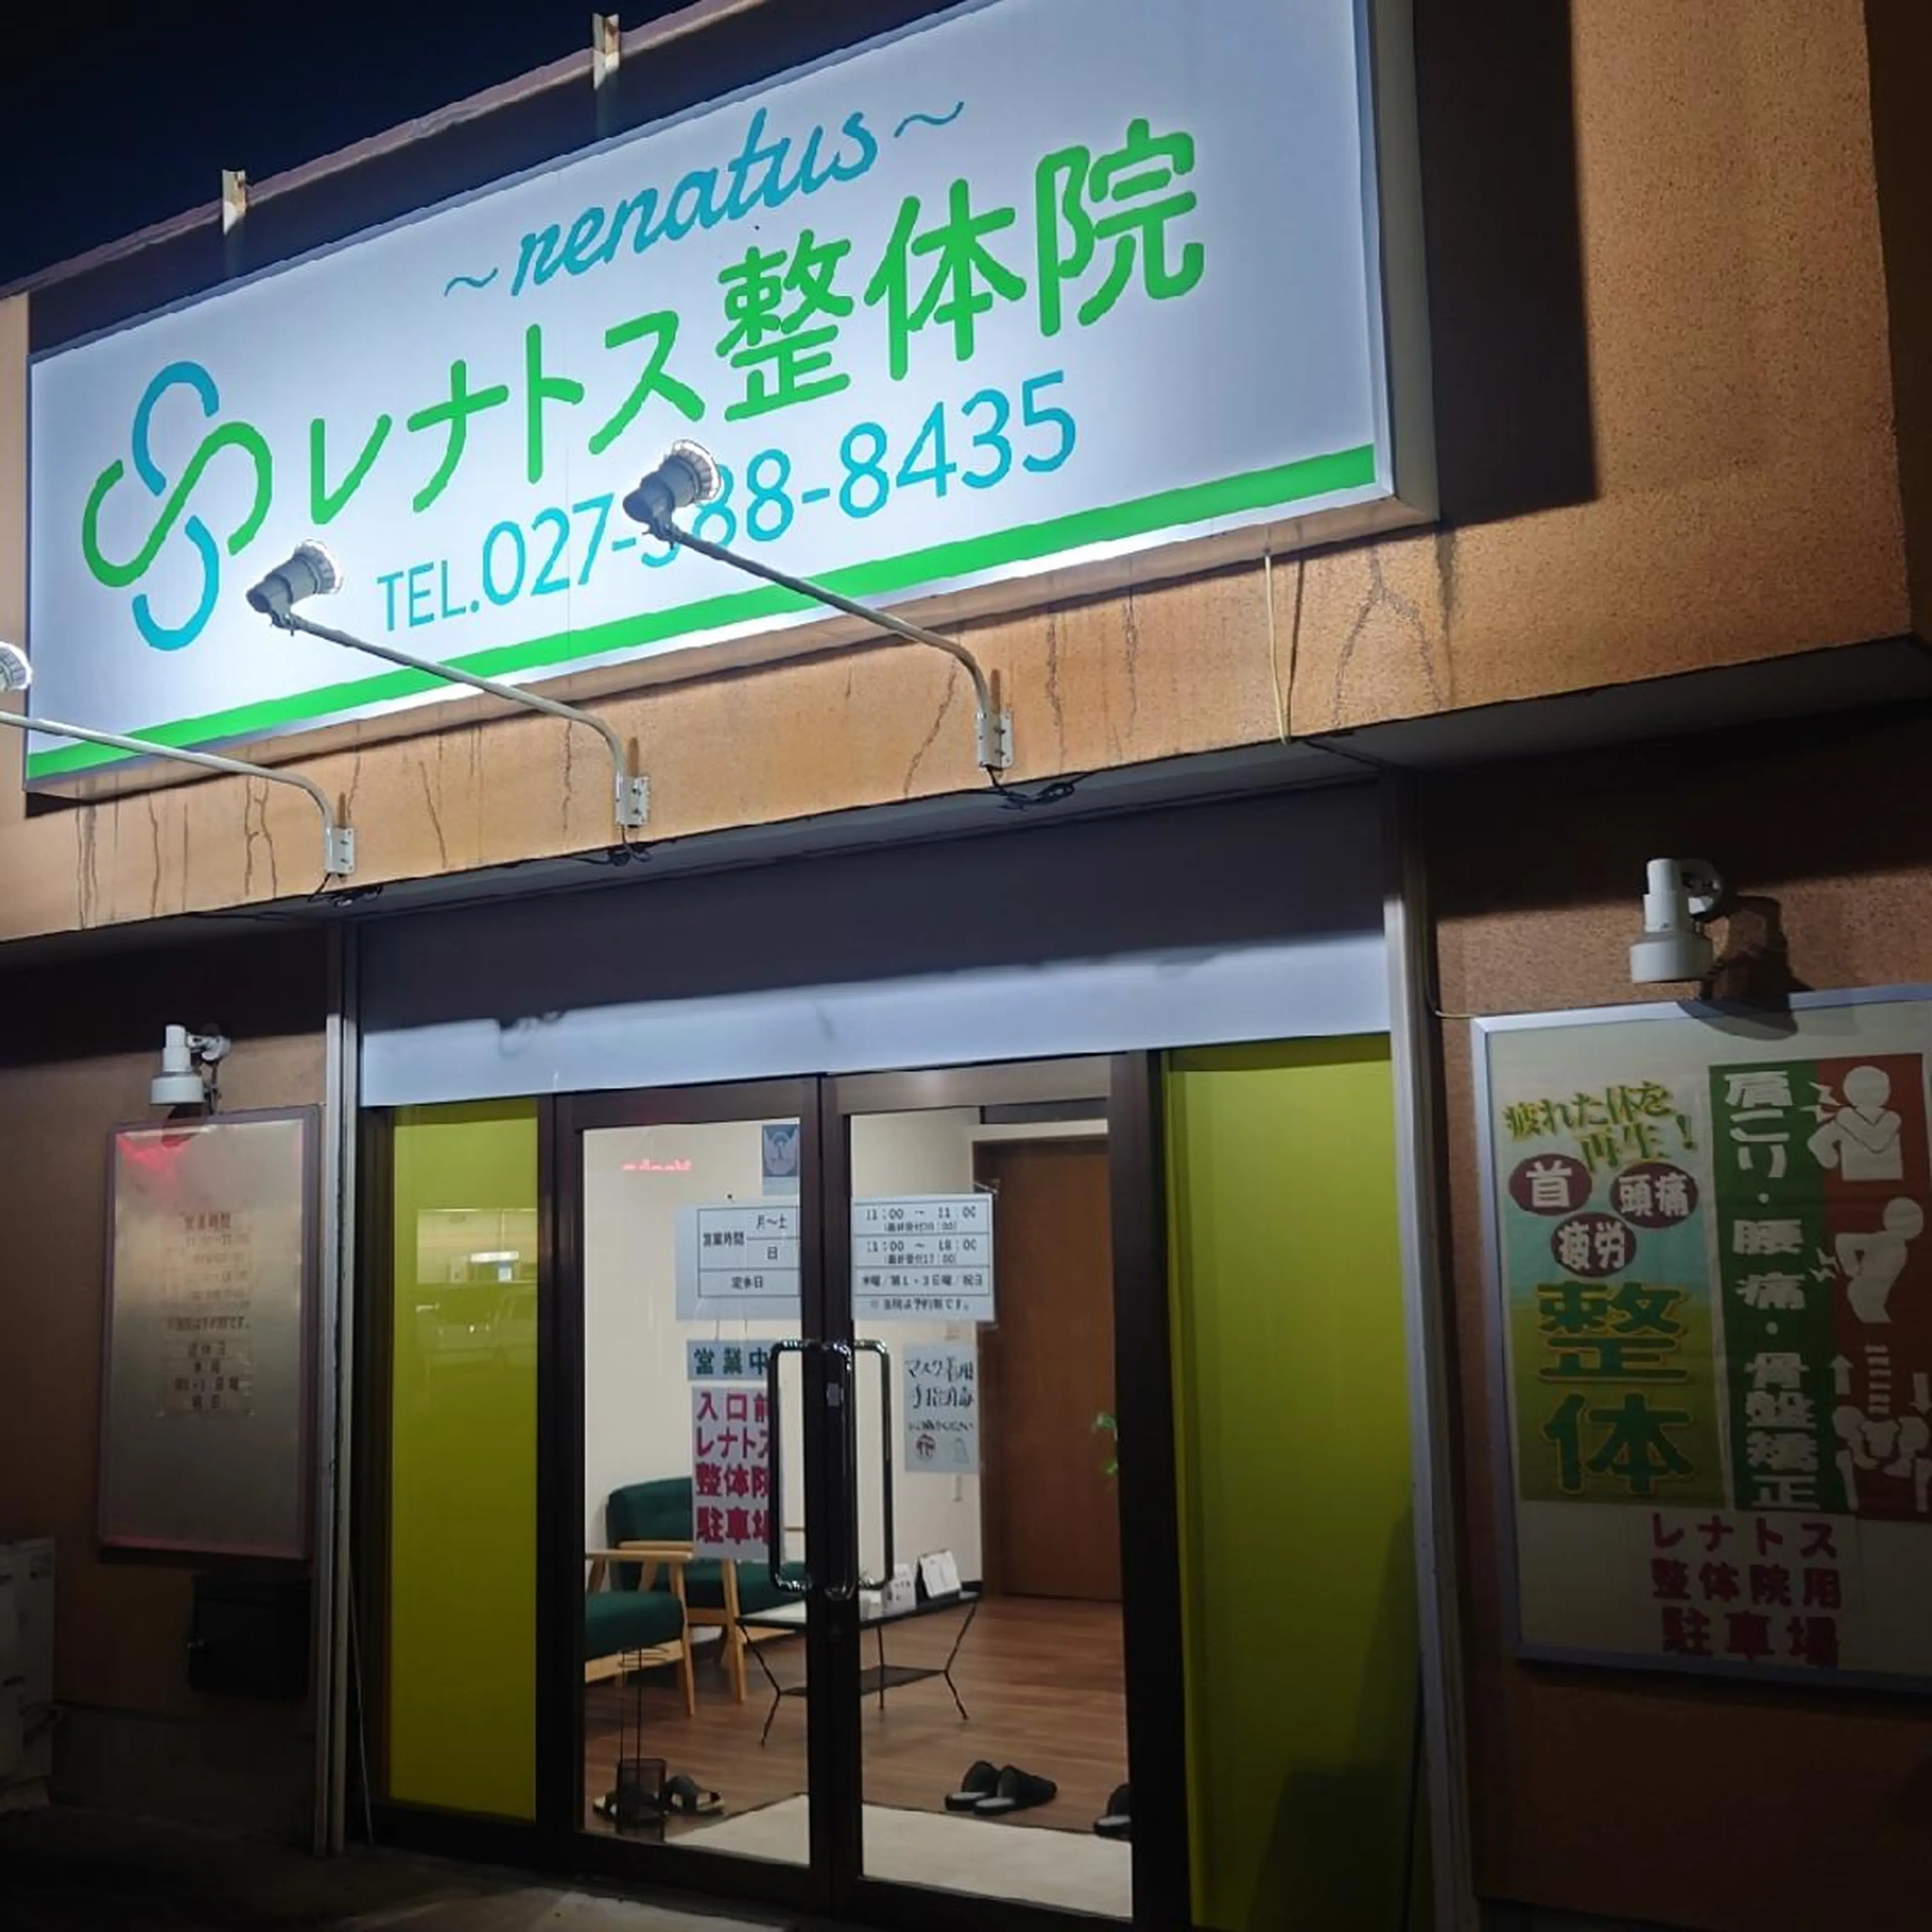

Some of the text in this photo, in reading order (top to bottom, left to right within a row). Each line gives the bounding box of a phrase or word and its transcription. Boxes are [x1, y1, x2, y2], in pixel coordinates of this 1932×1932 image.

[310, 118, 1204, 525] レナトス整体院
[1525, 1160, 1573, 1208] 首
[1618, 1172, 1689, 1218] 頭痛
[767, 1246, 778, 1260] 日
[1558, 1219, 1626, 1271] 疲労
[694, 1346, 769, 1376] 営業中
[1537, 1281, 1695, 1493] 整体
[1652, 1512, 1837, 1559] レナトス
[1650, 1557, 1842, 1609] 整体院用
[1661, 1605, 1839, 1670] 駐車場
